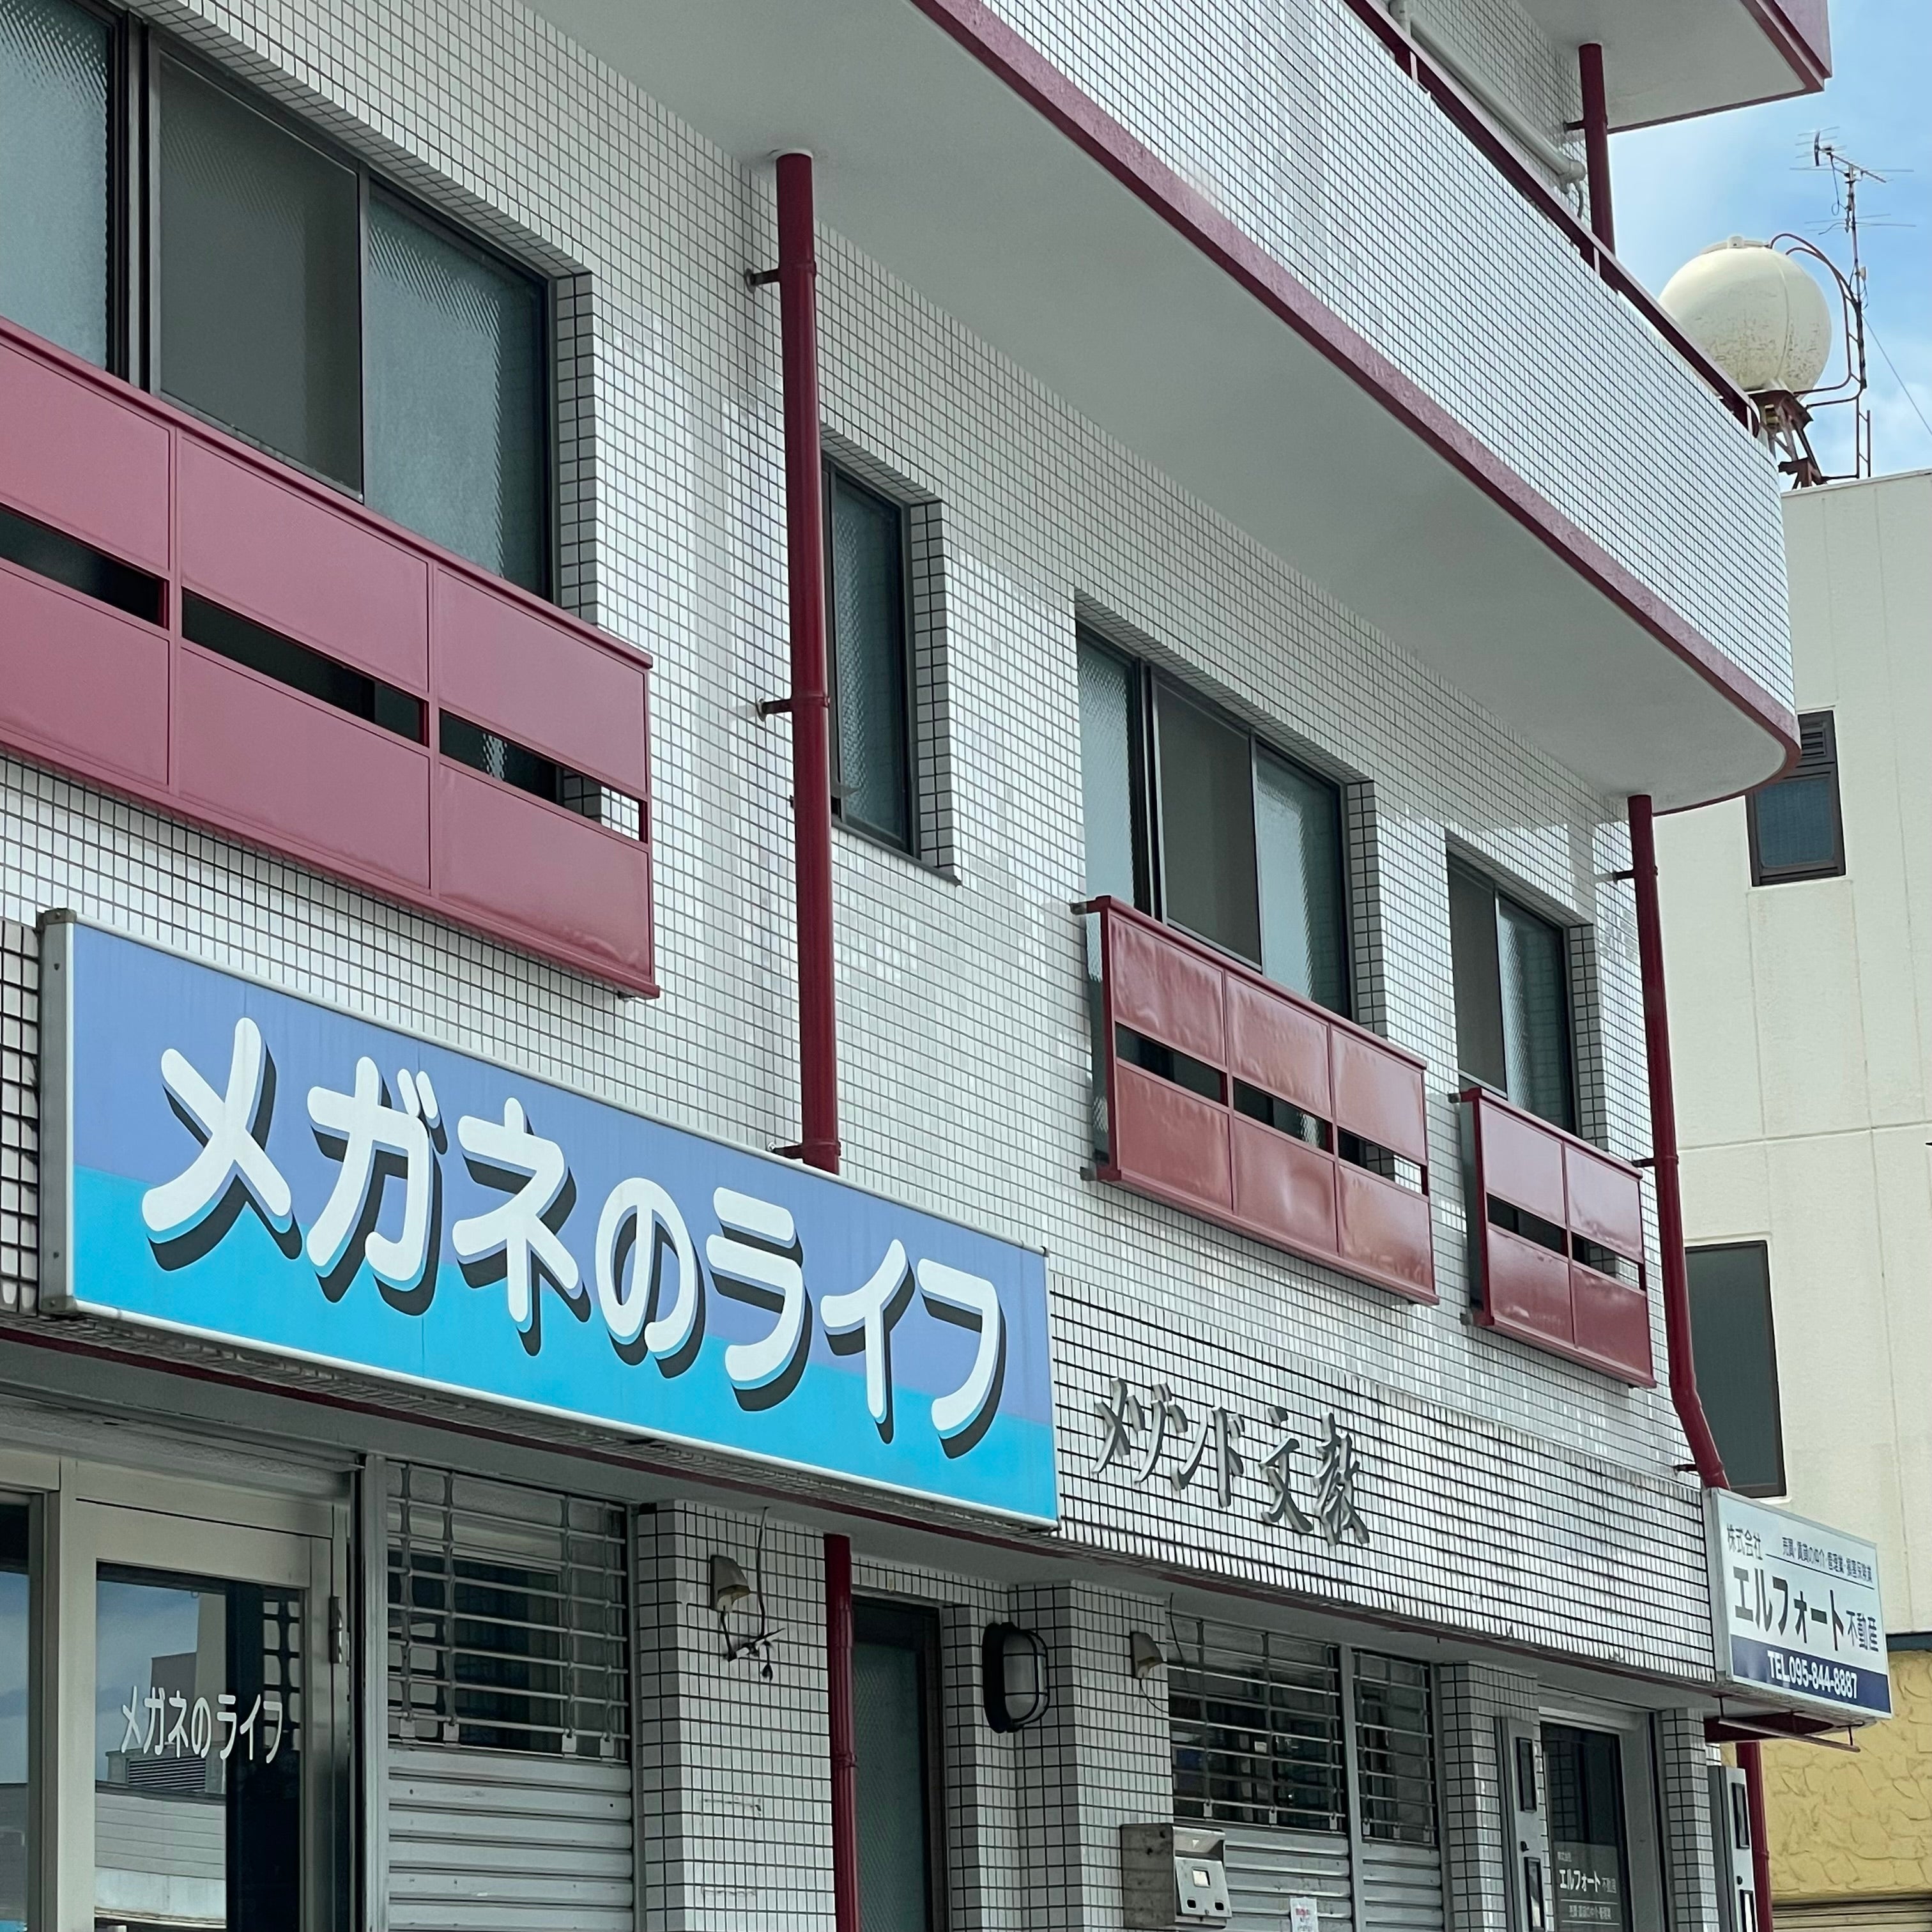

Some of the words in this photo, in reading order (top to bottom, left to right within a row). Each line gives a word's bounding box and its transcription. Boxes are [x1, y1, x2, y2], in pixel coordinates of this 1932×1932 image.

[141, 1016, 1006, 1459] メガネのライフ
[1091, 1377, 1370, 1546] メゾンド文教
[1727, 1523, 1763, 1561] 株式会社
[121, 1685, 283, 1764] メガネのライフ
